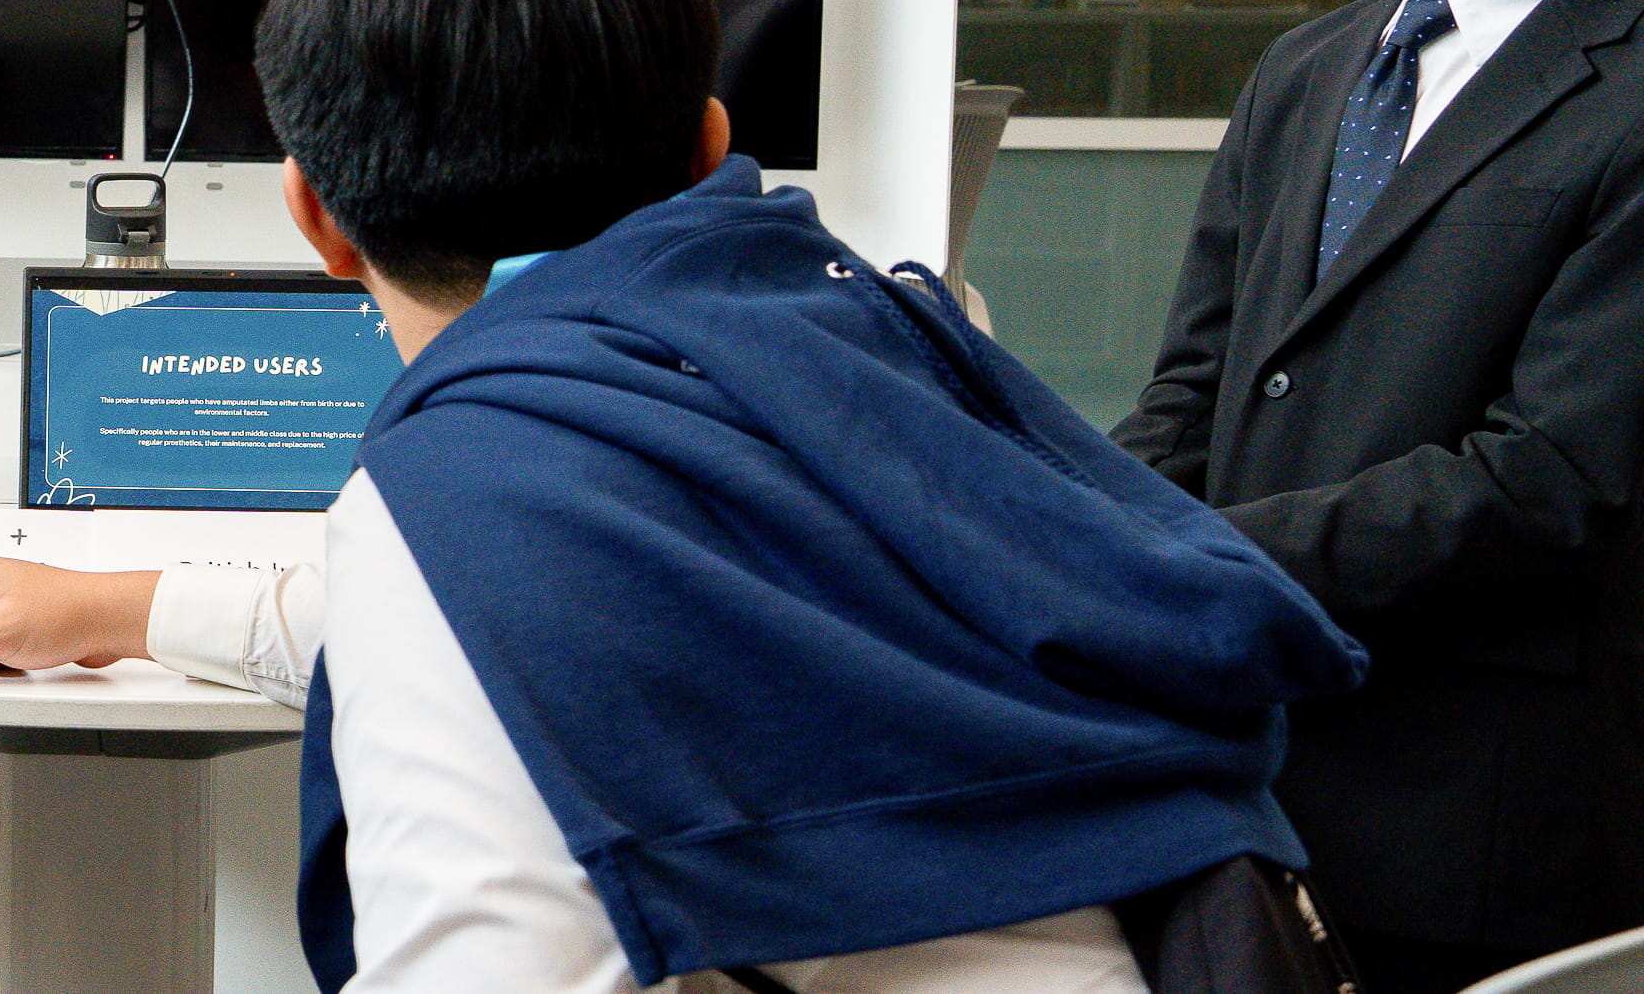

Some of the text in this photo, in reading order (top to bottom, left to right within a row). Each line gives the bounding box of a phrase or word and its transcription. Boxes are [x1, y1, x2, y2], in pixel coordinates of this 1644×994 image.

[141, 355, 323, 378] INTENDED USERS
[10, 527, 28, 546] +
